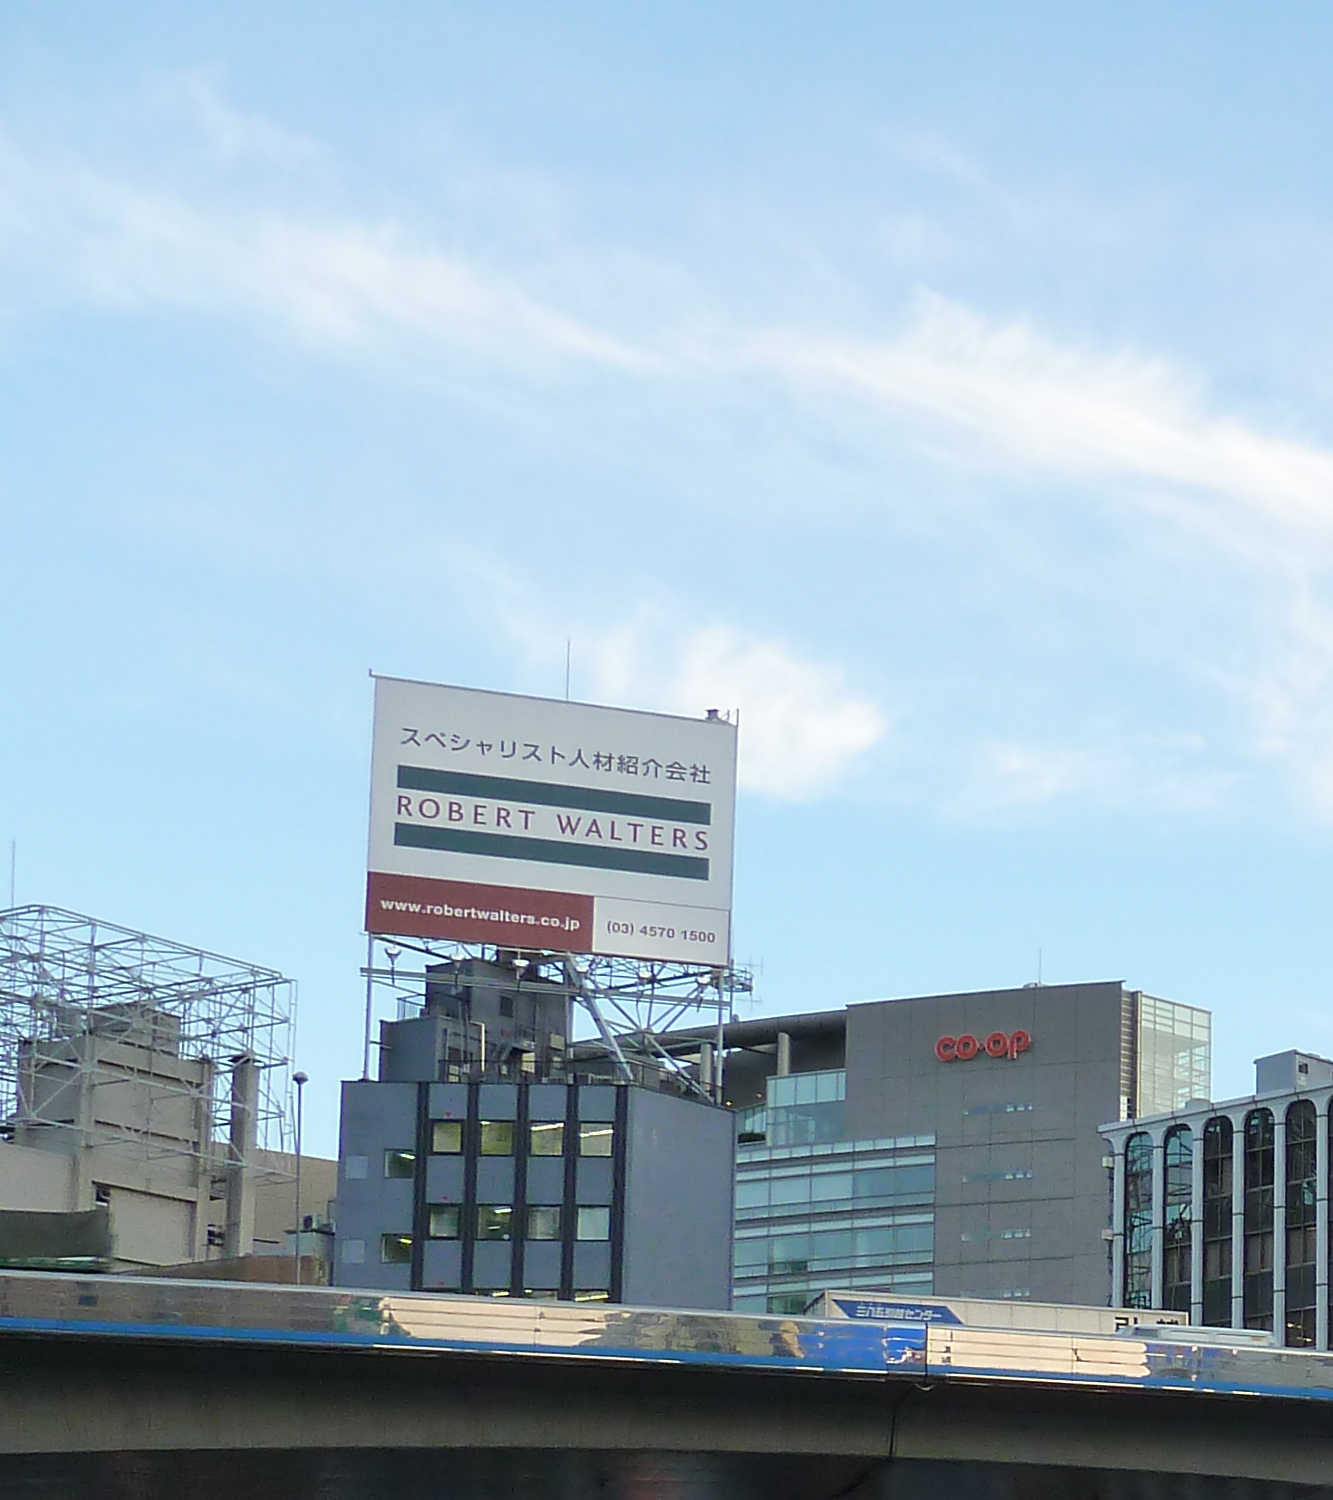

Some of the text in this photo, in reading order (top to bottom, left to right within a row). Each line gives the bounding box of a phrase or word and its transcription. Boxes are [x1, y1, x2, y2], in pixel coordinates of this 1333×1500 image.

[400, 727, 712, 784] スペシャリスト人材紹介会社
[397, 795, 709, 851] ROBERT WALTERS
[380, 899, 580, 931] www.robertwalters.co.jp
[607, 920, 715, 943] (03) 4570 1500
